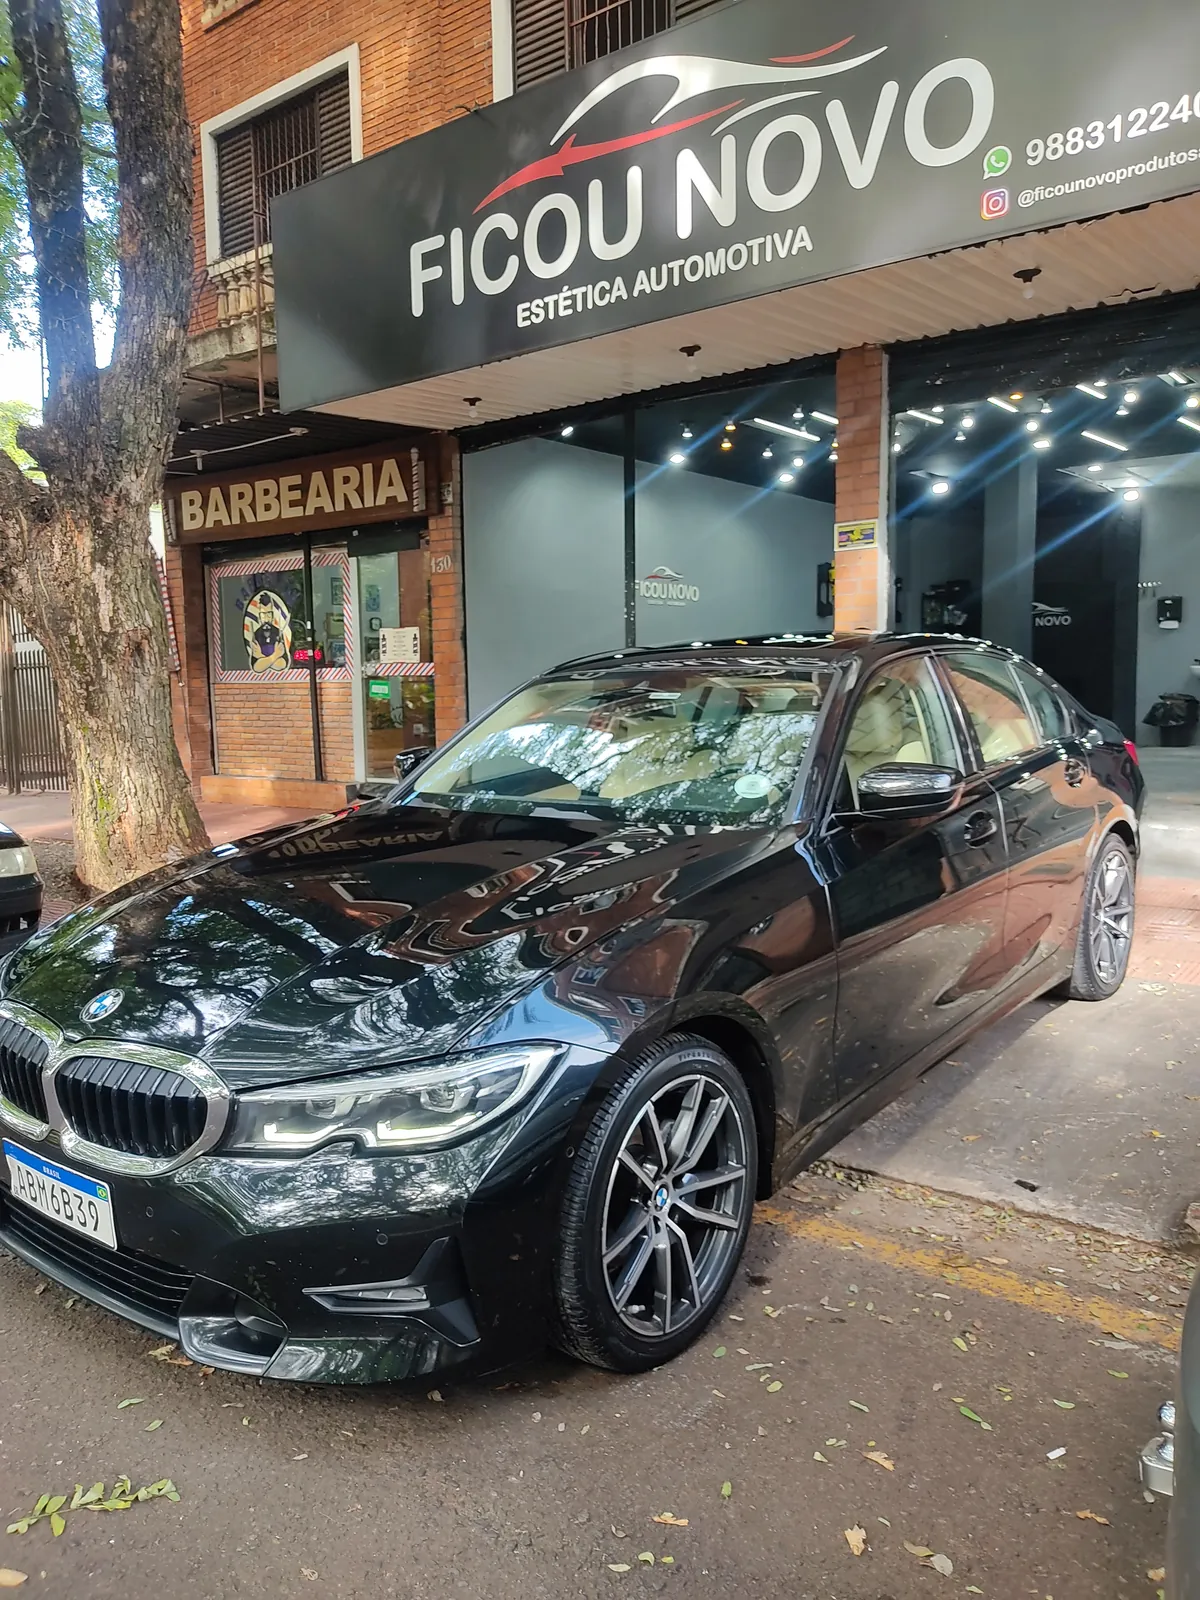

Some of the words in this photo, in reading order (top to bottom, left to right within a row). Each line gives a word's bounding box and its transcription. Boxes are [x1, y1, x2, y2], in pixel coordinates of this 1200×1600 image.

[410, 165, 644, 318] FICOU
[676, 58, 995, 240] NOVO
[1017, 147, 1200, 208] @ficounovoprodutos
[516, 276, 628, 328] ESTÉTICA
[633, 225, 814, 298] AUTOMOTIVA
[181, 458, 408, 531] BARBEARIA
[668, 583, 700, 601] NOVO
[1035, 615, 1072, 627] NOVO
[17, 1164, 99, 1232] ABM6B39
[42, 1165, 61, 1179] BRASIL
